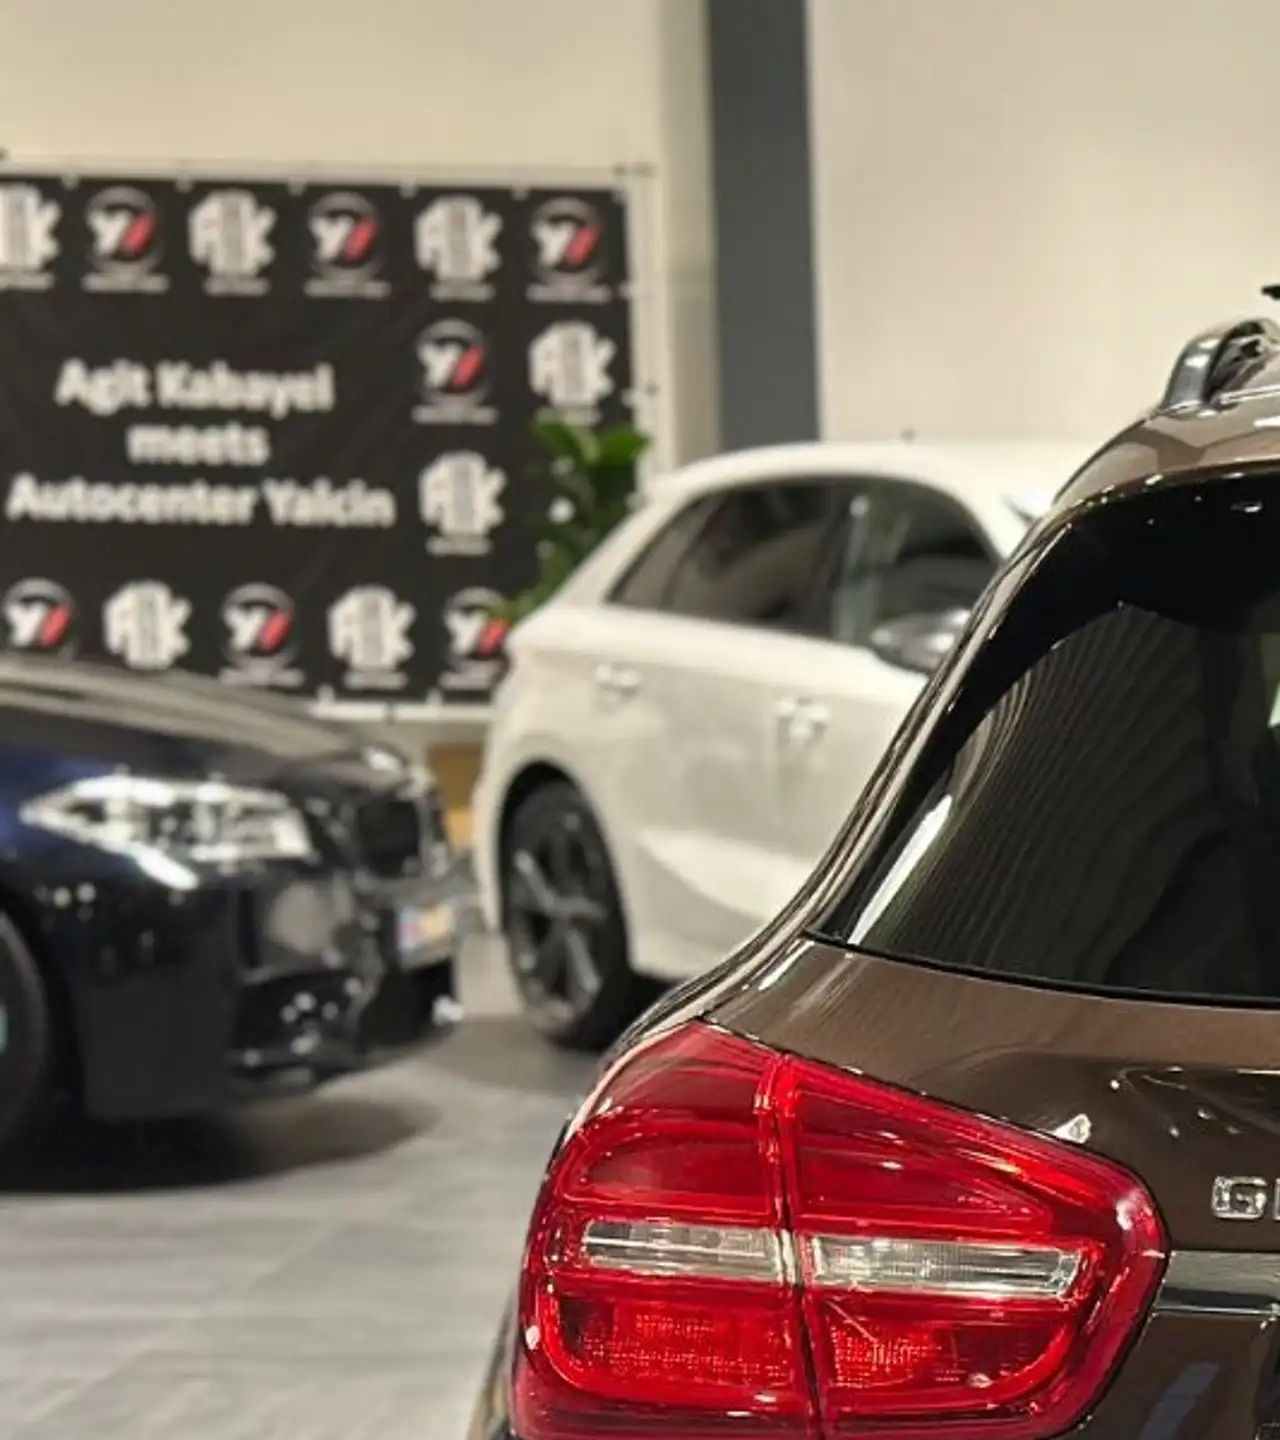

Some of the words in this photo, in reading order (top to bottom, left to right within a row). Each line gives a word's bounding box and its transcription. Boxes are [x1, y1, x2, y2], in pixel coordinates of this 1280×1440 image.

[126, 421, 269, 464] meets
[6, 472, 258, 524] Autocenter
[262, 476, 396, 528] Yalcin
